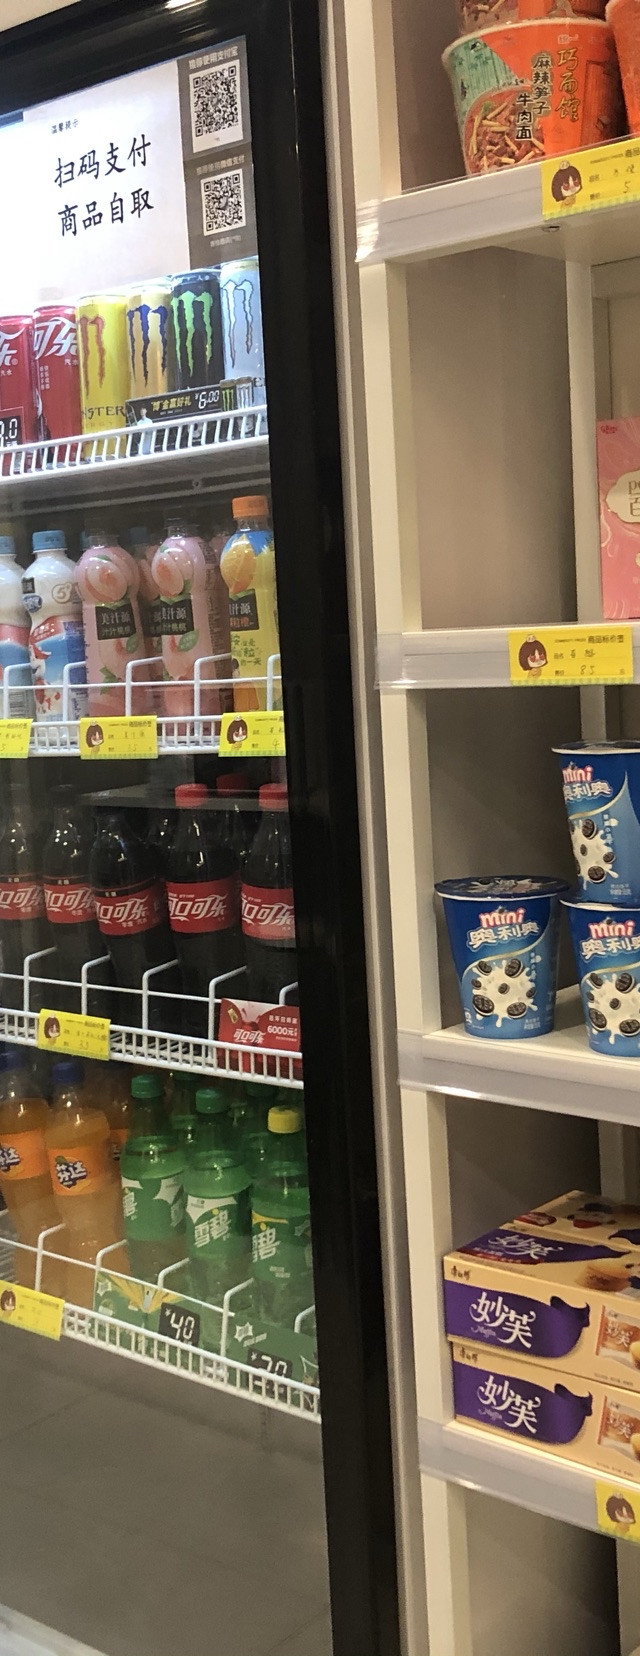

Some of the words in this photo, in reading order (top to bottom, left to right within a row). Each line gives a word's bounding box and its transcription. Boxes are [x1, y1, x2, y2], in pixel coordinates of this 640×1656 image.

[533, 53, 552, 115] 麻辣笋子
[516, 92, 534, 141] 牛肉面
[54, 134, 151, 188] 扫码支付
[58, 187, 154, 237] 商品自取
[467, 921, 539, 949] 奥利奥
[480, 908, 525, 927] mini
[588, 919, 635, 939] mini
[56, 1161, 87, 1184] 芬达
[194, 1210, 231, 1248] 雪碧
[469, 1291, 537, 1349] 妙芙
[477, 1375, 542, 1434] 妙芙
